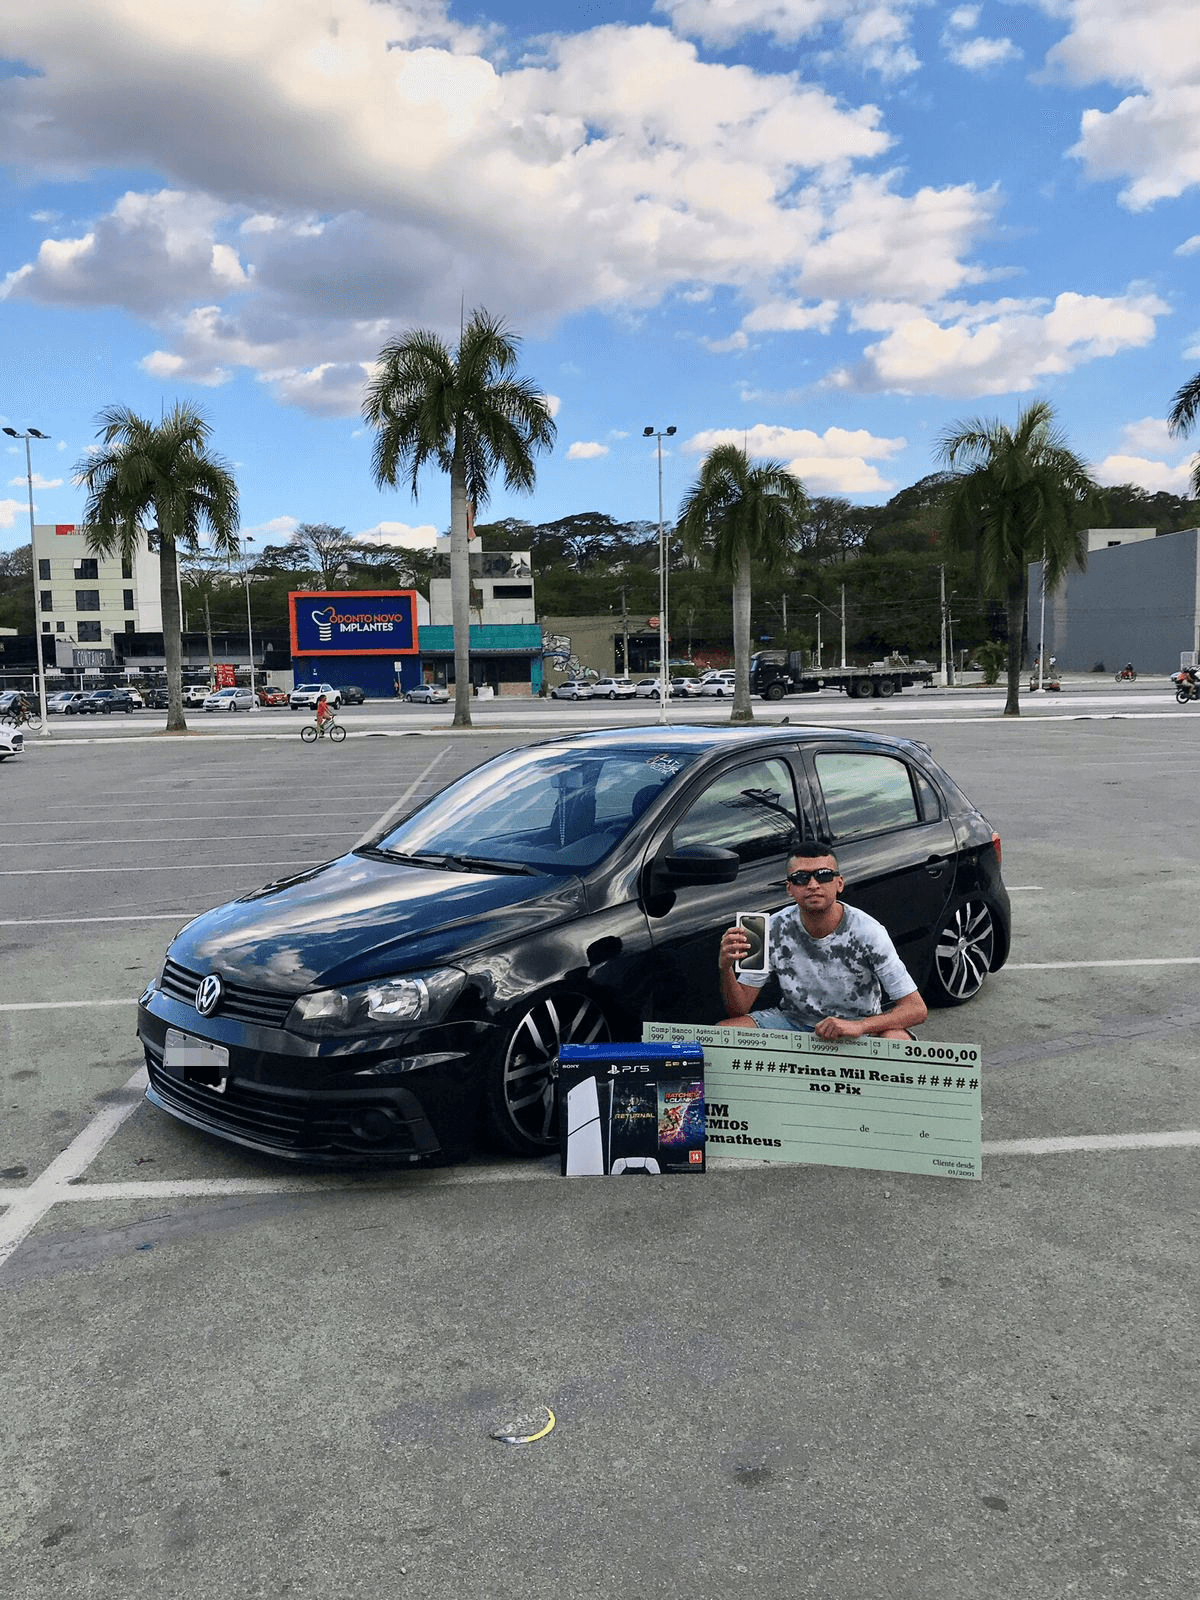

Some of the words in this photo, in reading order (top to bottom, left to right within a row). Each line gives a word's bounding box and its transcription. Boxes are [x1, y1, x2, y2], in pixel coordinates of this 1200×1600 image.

[329, 614, 372, 624] ODONTO
[374, 613, 403, 623] NOVO
[340, 622, 394, 632] IMPLANTES
[650, 1033, 665, 1041] 999
[671, 1034, 685, 1042] 999
[696, 1036, 714, 1044] 9999
[737, 1038, 767, 1047] 99999-9
[811, 1043, 839, 1052] 999999
[651, 1026, 670, 1034] Comp
[769, 1033, 788, 1041] Conta
[904, 1045, 978, 1062] 30.000,00
[621, 1065, 650, 1073] PS5
[839, 1067, 866, 1080] Mil
[869, 1070, 914, 1084] Reais
[809, 1082, 831, 1093] no
[834, 1082, 862, 1096] Pix
[859, 1124, 870, 1133] de
[919, 1130, 930, 1139] de
[933, 1159, 955, 1168] Cliente
[956, 1161, 975, 1170] desde
